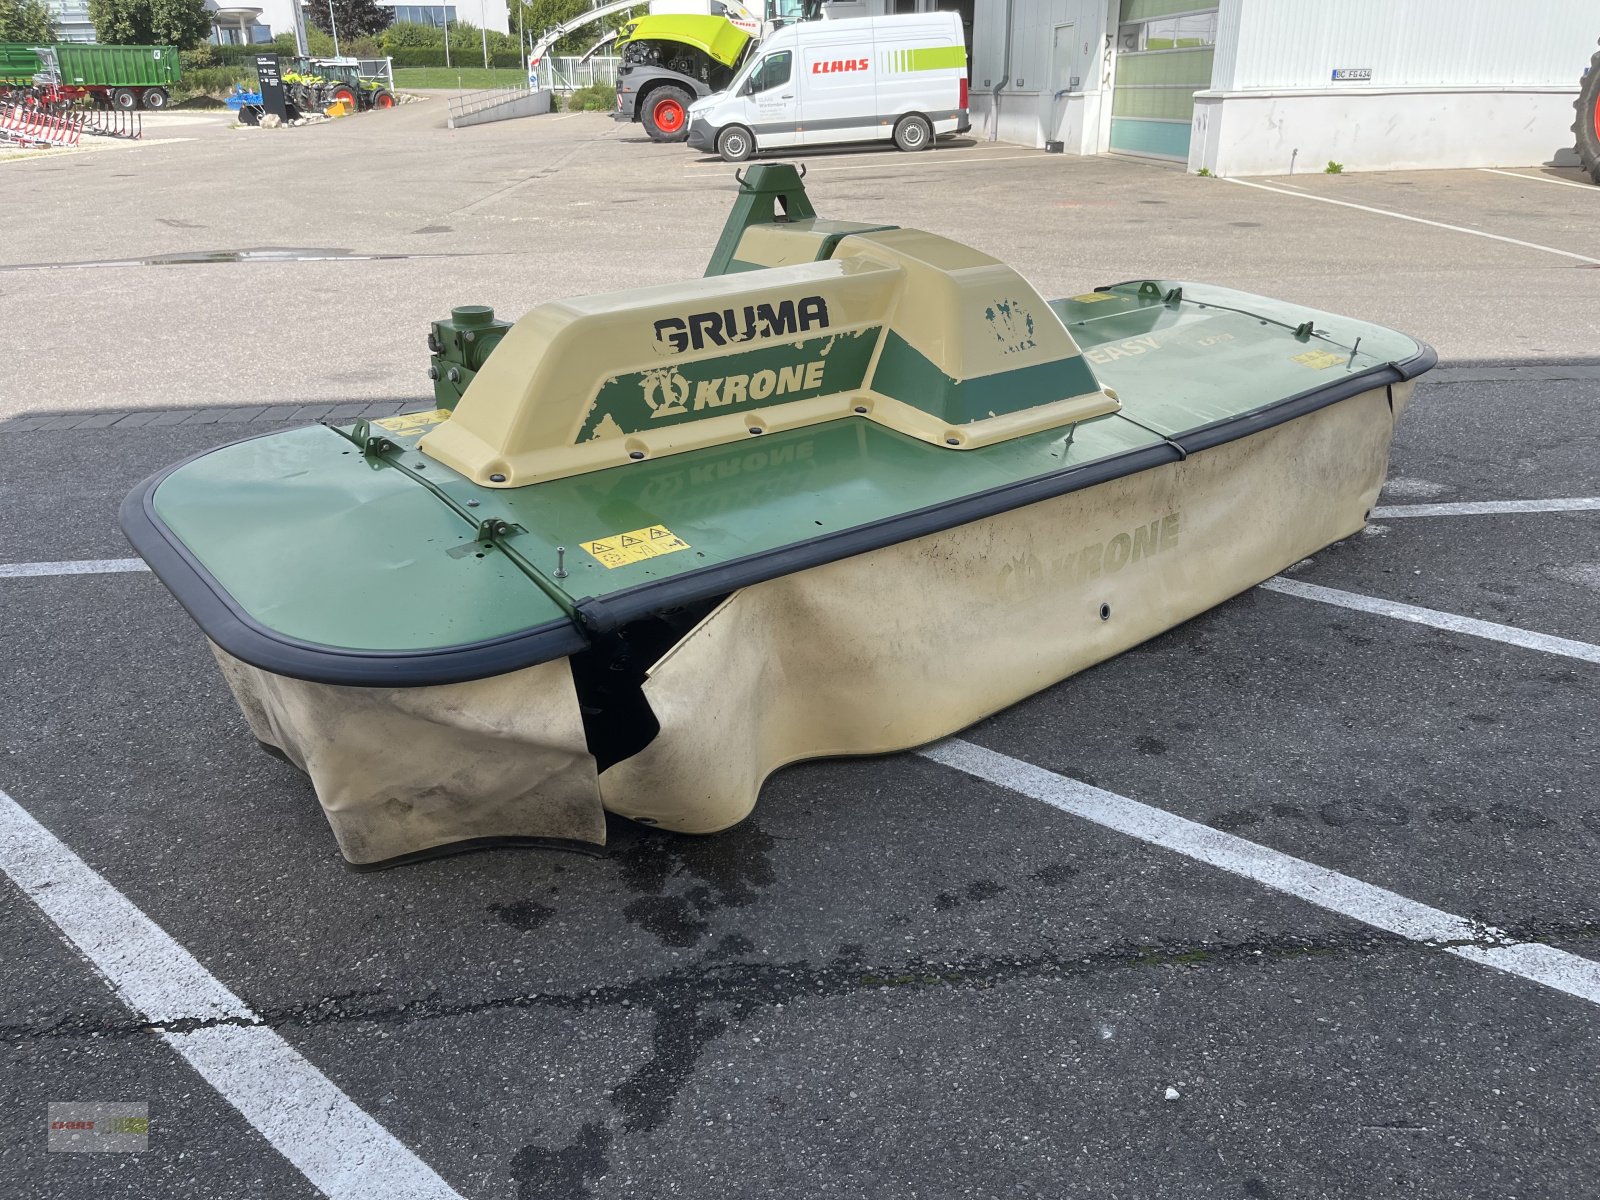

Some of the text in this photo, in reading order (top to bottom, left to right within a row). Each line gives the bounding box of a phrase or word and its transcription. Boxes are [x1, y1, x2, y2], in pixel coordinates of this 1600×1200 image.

[731, 20, 757, 28] CLAAS
[812, 58, 869, 74] CLAAS
[653, 295, 830, 354] GRUMA
[1086, 336, 1162, 366] EASY
[693, 360, 826, 411] KRONE
